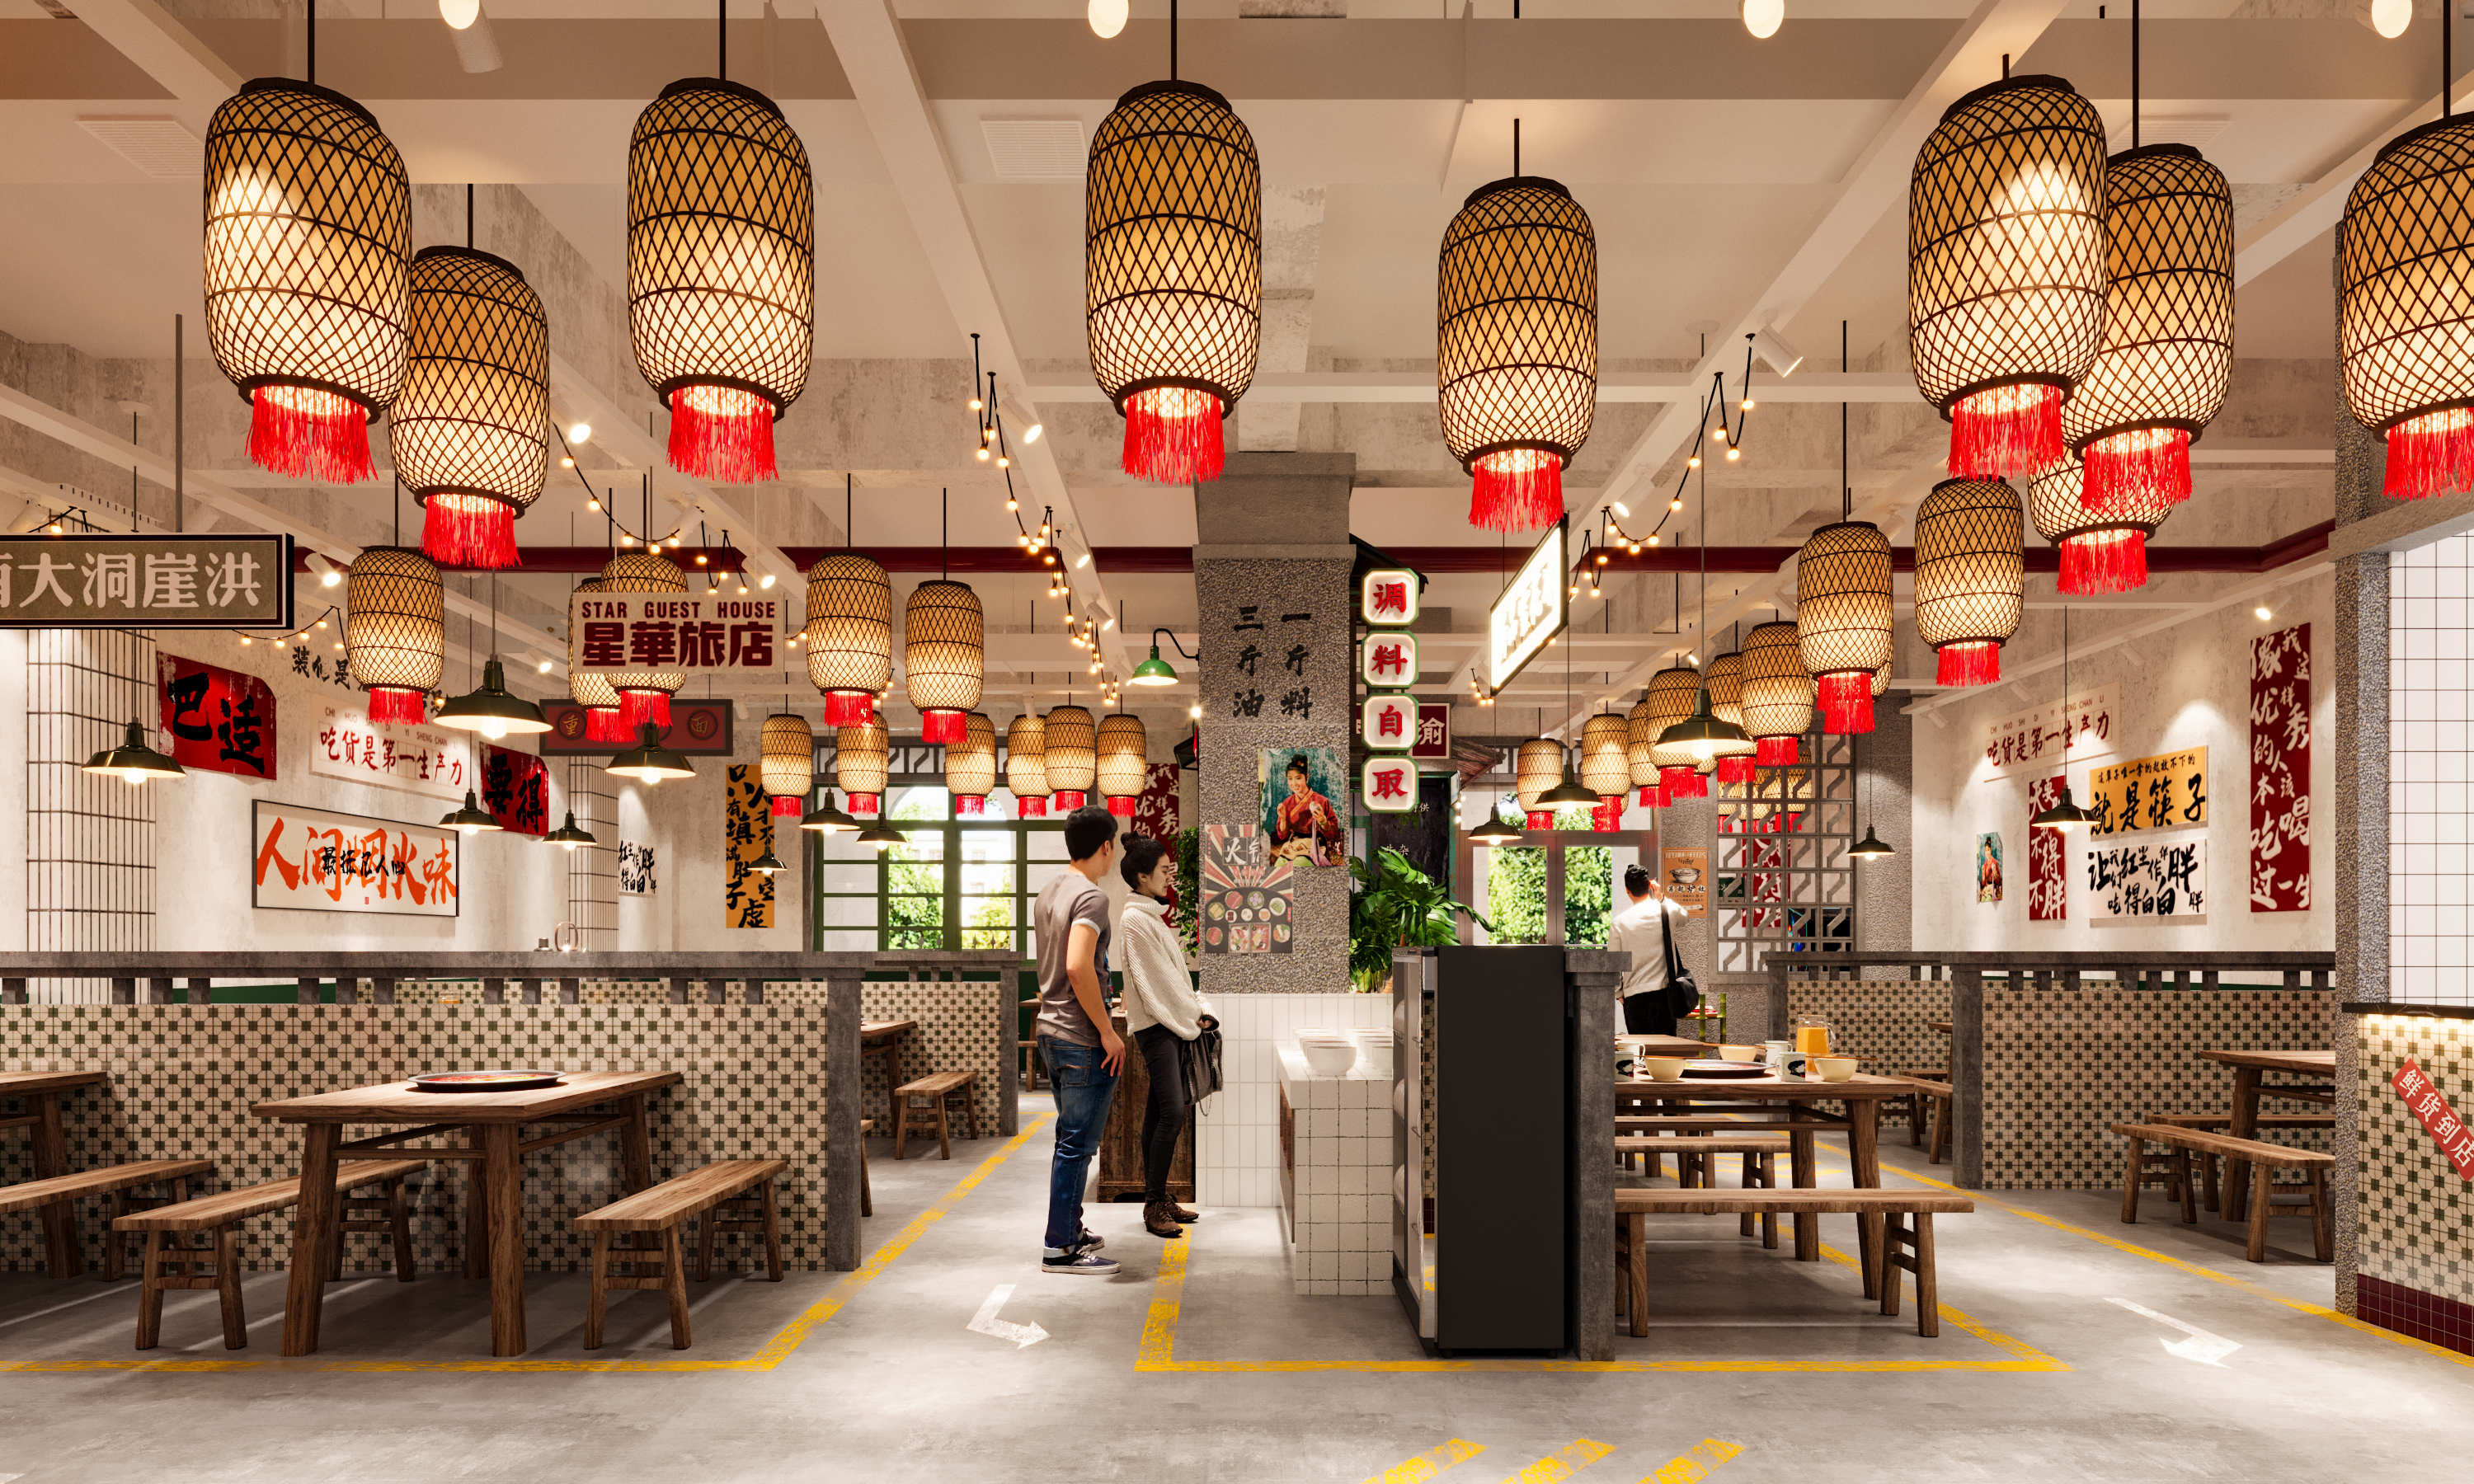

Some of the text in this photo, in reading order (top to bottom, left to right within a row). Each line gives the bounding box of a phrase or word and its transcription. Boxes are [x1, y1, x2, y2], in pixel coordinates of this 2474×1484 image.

[581, 601, 775, 619] STAR GUEST HOUSE
[582, 621, 774, 668] 星華旅店
[1281, 613, 1313, 721] 一斤料
[1372, 581, 1408, 800] 调料自取
[2003, 721, 2013, 730] HUO
[2079, 697, 2092, 709] CHAN
[167, 671, 265, 775] 巴适
[325, 707, 336, 718] CHI
[345, 712, 358, 723] HUO
[416, 731, 433, 743] SHENG
[435, 735, 448, 747] CHAN
[563, 714, 709, 735] 重面
[1987, 711, 2109, 767] 吃货是第一生产力
[320, 726, 463, 786] 吃货是第一生产力
[484, 753, 543, 834] 要得
[2090, 773, 2206, 836] 就是筷子
[256, 817, 456, 905] 人间烟火味
[2399, 1068, 2474, 1167] 鲜货到店
